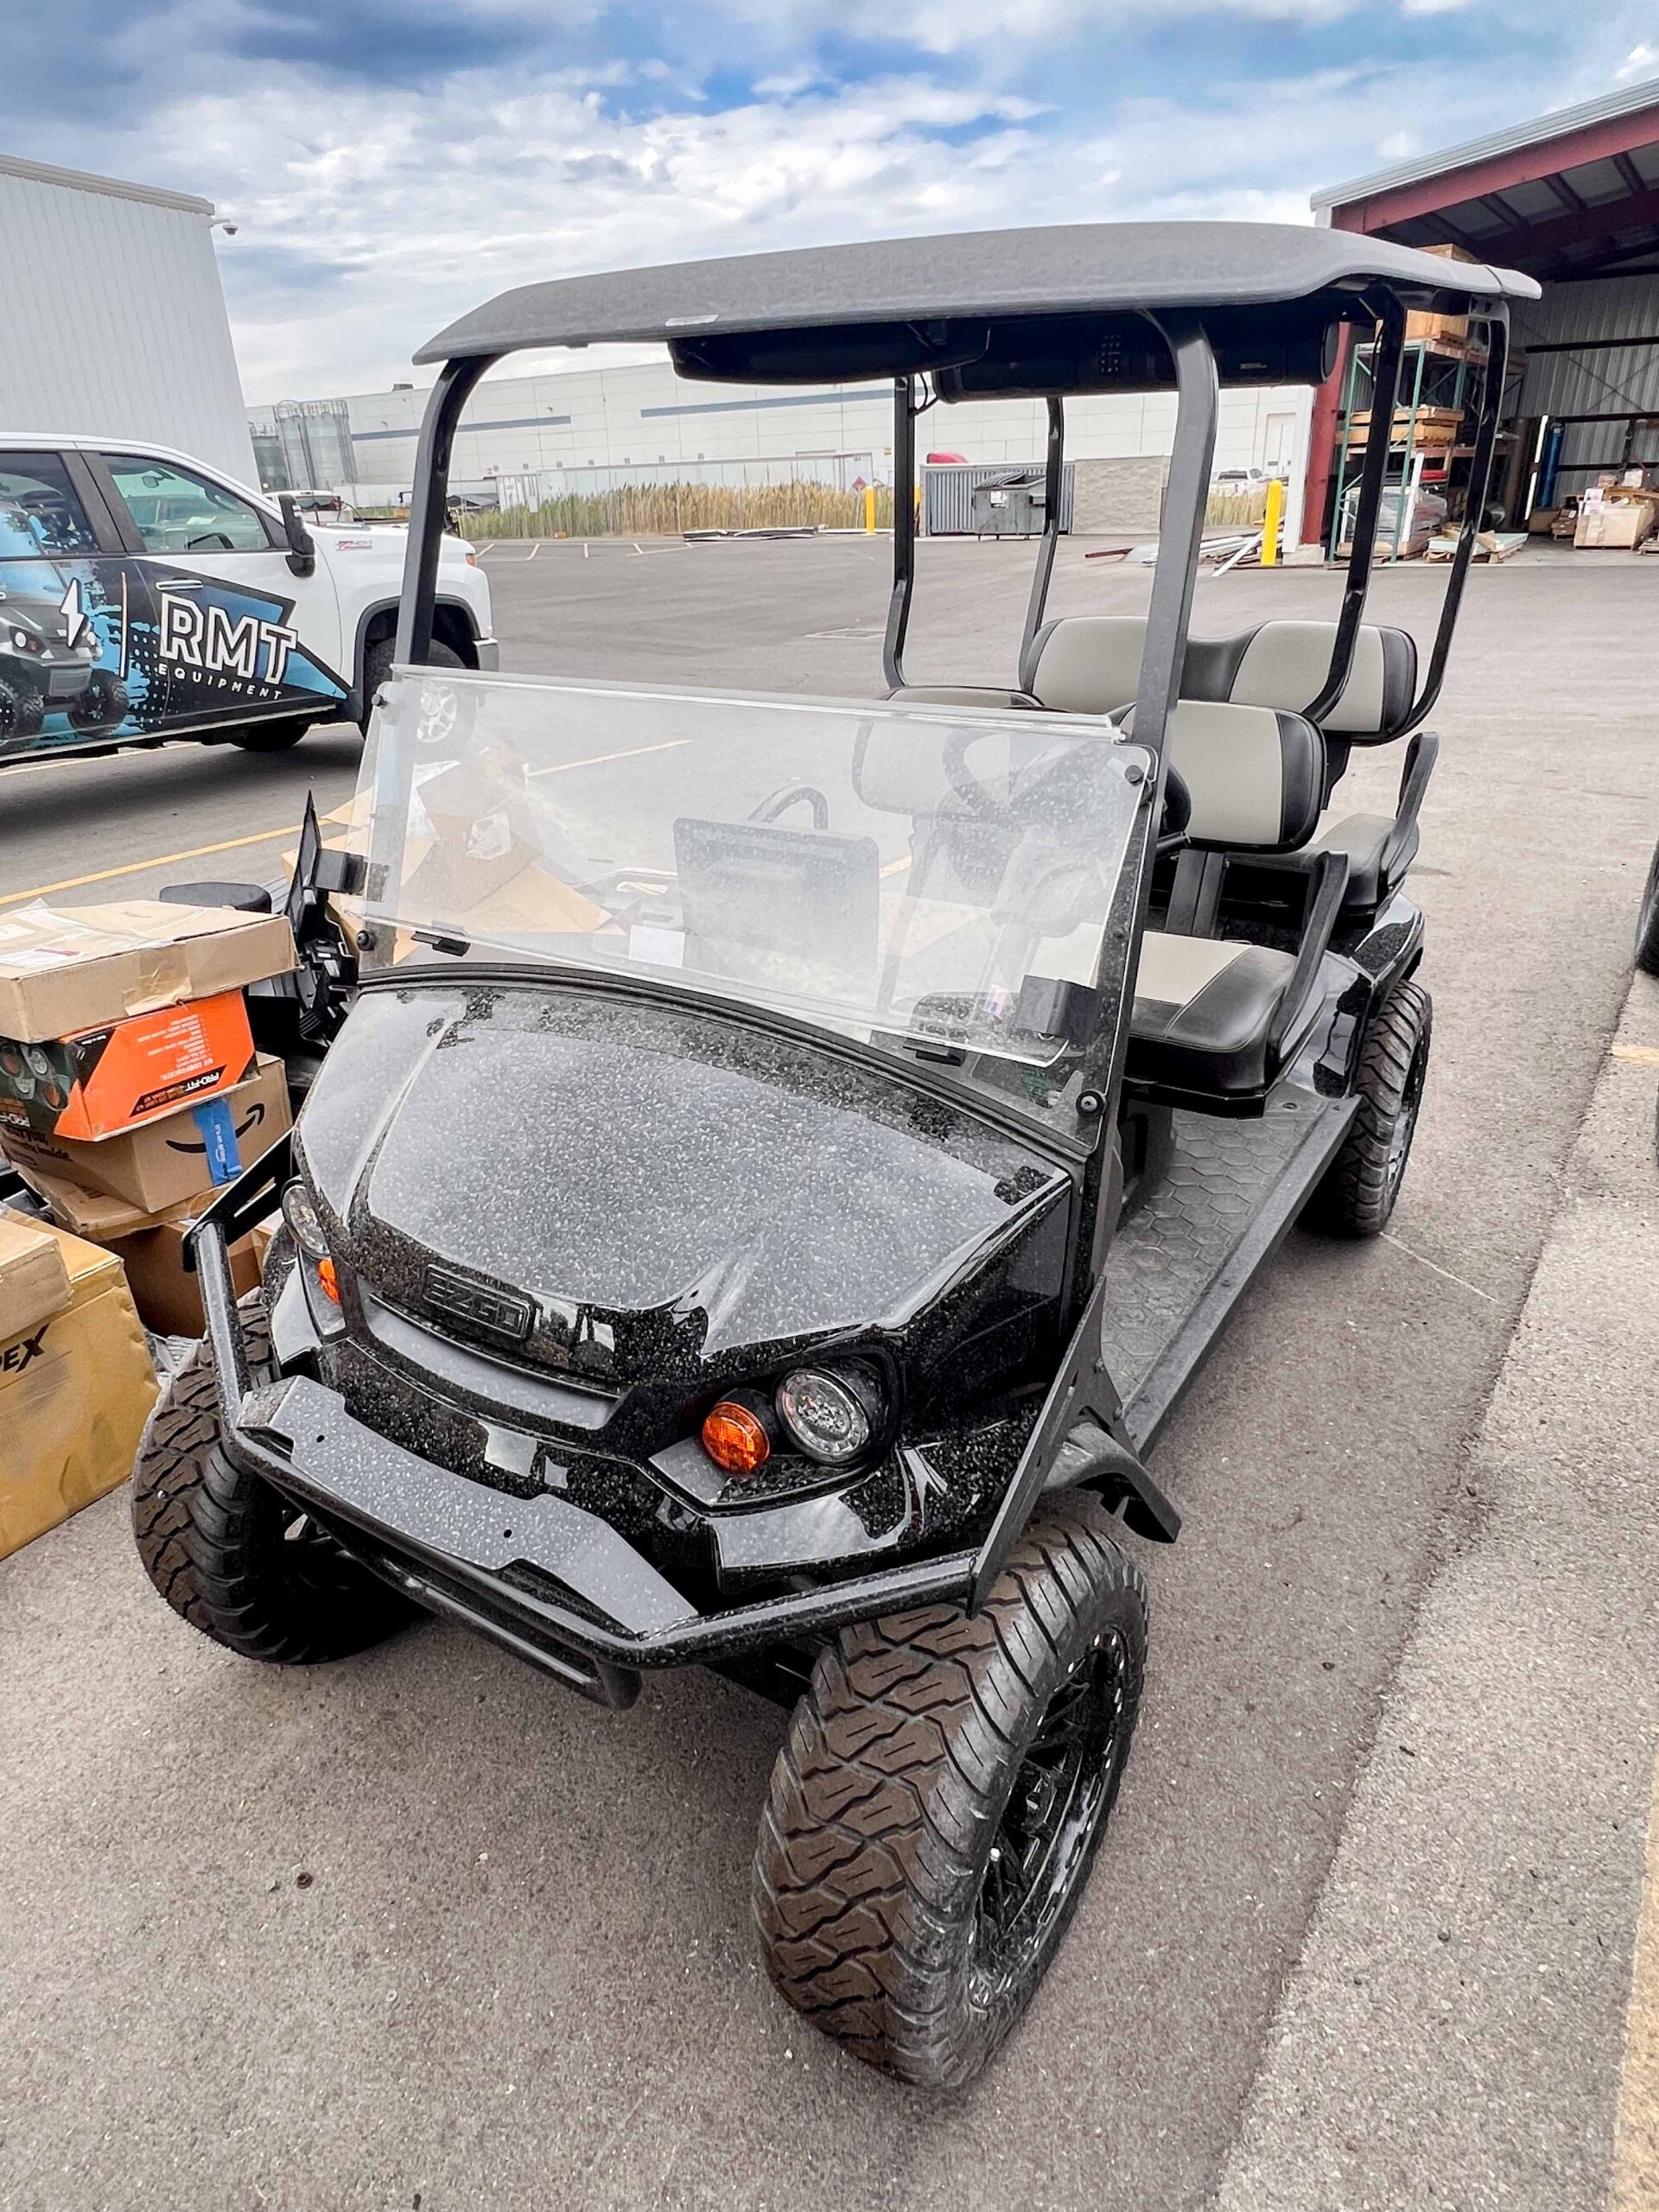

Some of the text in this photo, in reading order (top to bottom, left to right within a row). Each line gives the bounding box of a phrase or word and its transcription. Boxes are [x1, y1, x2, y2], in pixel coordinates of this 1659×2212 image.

[160, 593, 298, 685] RMT
[158, 663, 282, 700] EQUIPMENT
[184, 1071, 219, 1092] PRO-FIT
[0, 1322, 50, 1374] EX
